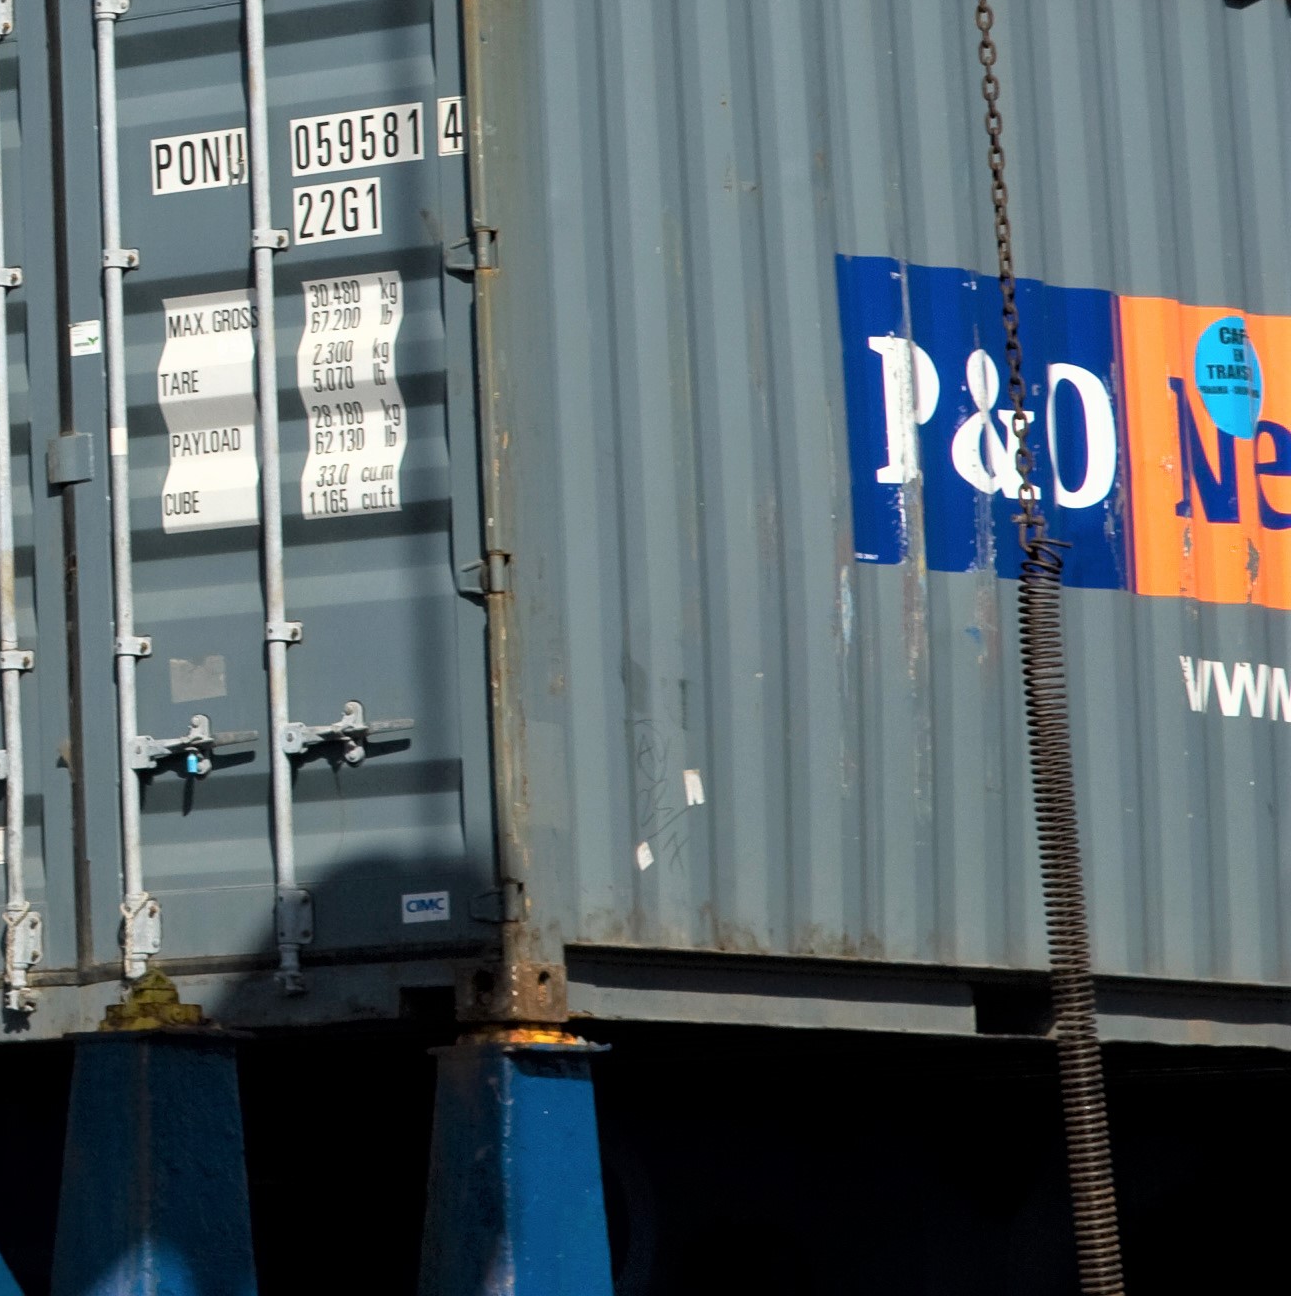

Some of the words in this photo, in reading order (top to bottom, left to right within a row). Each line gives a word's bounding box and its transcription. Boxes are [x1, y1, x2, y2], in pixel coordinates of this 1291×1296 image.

[155, 133, 243, 190] PONU
[295, 108, 419, 170] 059581
[444, 103, 463, 149] 4
[299, 183, 378, 239] 22G1
[310, 279, 361, 309] 30.480
[378, 277, 397, 305] kg
[168, 312, 210, 339] MAX.
[212, 305, 258, 333] GROSS
[310, 306, 361, 334] 67.200
[380, 304, 393, 326] lb
[313, 340, 354, 366] 2.300
[373, 337, 390, 365] kg
[161, 369, 199, 397] TARE
[313, 365, 355, 393] 5.070
[373, 362, 387, 386] lb
[312, 401, 364, 429] 28.180
[381, 398, 402, 427] kg
[868, 335, 1117, 509] P&O
[172, 427, 241, 458] PAYLOAD
[315, 427, 365, 455] 62.130
[384, 424, 397, 447] lb
[316, 463, 350, 488] 33.0
[164, 490, 200, 516] CUBE
[309, 488, 349, 515] 1.165
[361, 484, 396, 510] cu.ft
